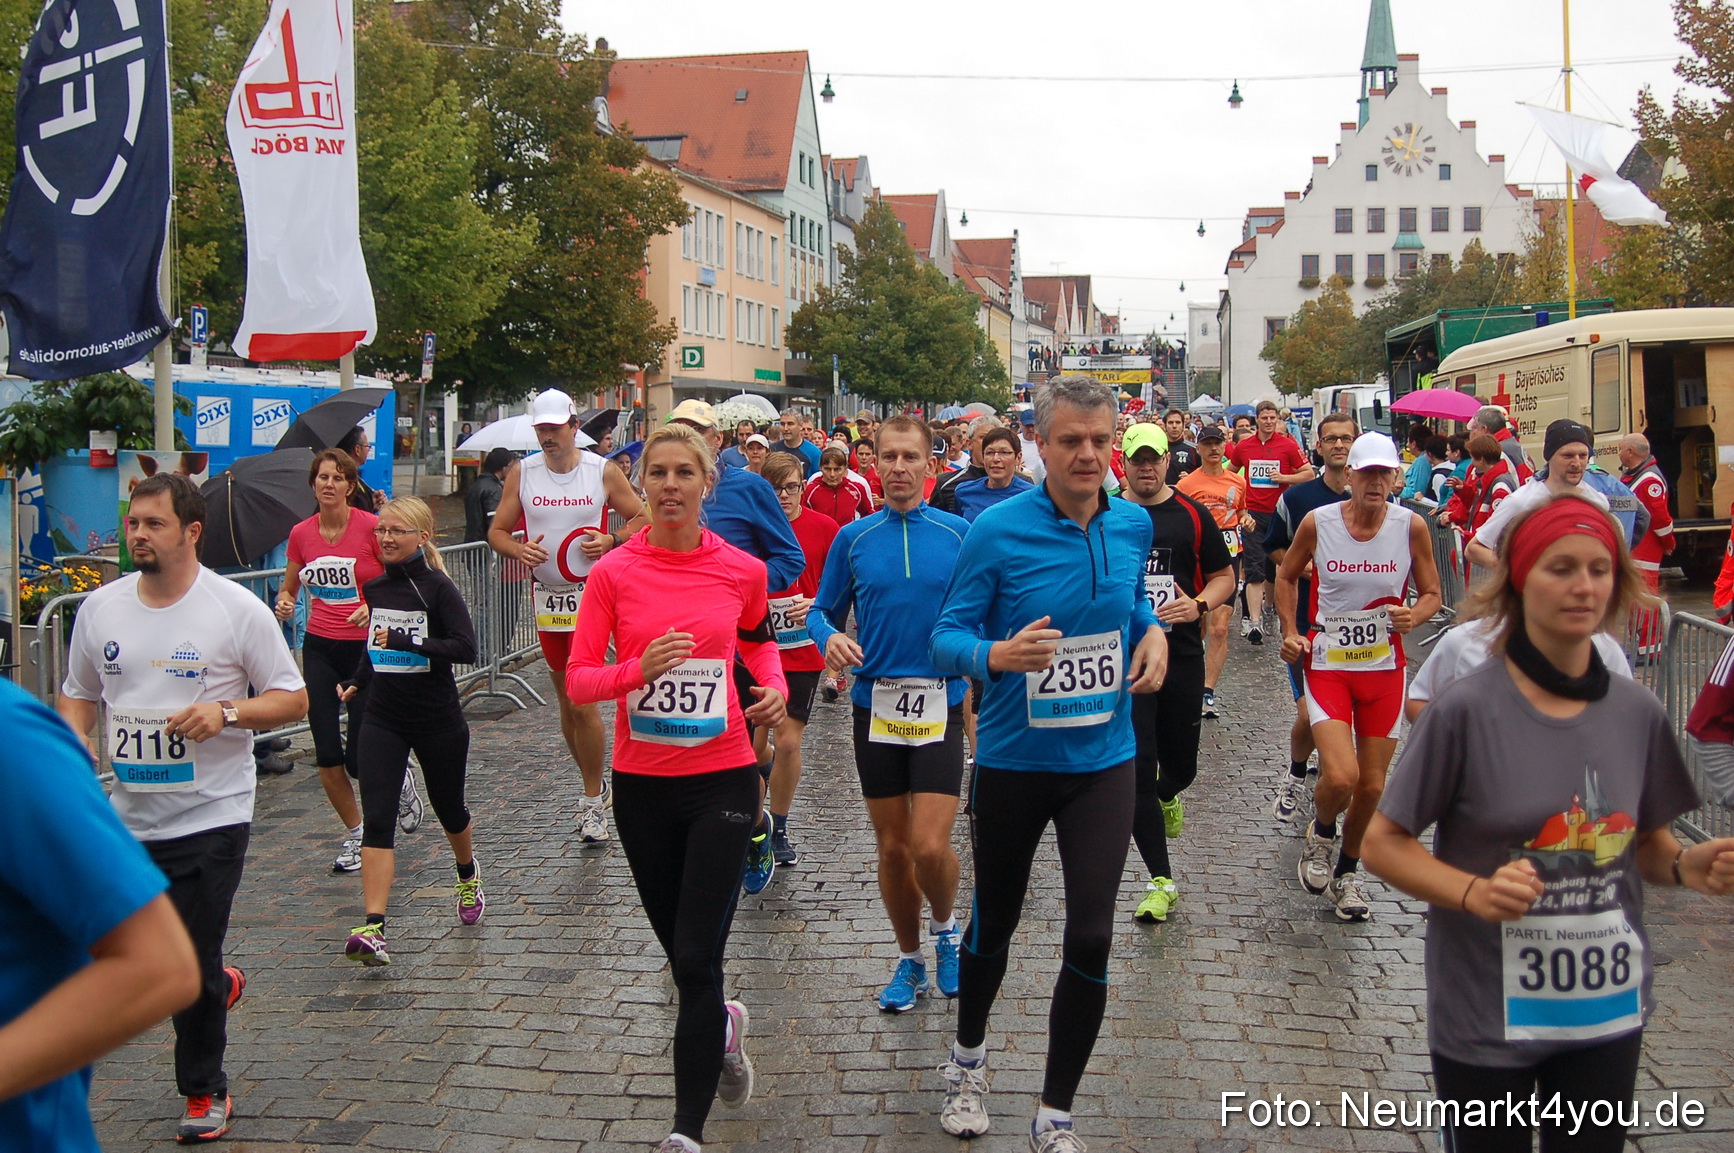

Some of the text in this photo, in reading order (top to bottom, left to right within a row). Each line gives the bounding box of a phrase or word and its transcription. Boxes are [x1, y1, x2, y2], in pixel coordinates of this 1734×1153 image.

[194, 311, 204, 338] P
[685, 350, 700, 365] D
[1515, 366, 1564, 392] Bayerisches
[1514, 394, 1538, 411] Rotes
[532, 496, 593, 506] Oberbank
[1327, 560, 1397, 573] Oberbank
[305, 568, 350, 586] 2088
[546, 595, 577, 612] 476
[778, 633, 799, 642] anuel
[1338, 623, 1376, 646] 389
[1062, 643, 1105, 655] Neumarkt
[1346, 651, 1372, 660] Martin
[380, 653, 411, 664] Simone
[1038, 655, 1115, 694] 2356
[876, 680, 898, 690] PARTL
[637, 680, 716, 713] 2357
[895, 692, 925, 718] 44
[1052, 698, 1103, 715] Berthold
[113, 714, 172, 725] PARTL Neumar
[655, 722, 698, 734] Sandra
[888, 723, 930, 735] Christian
[116, 728, 186, 759] 2118
[128, 768, 169, 780] Gisbert
[1542, 877, 1586, 890] ensburg
[1562, 889, 1591, 907] Mai
[1505, 926, 1620, 941] PARTL Neumarkt
[1518, 941, 1630, 992] 3088
